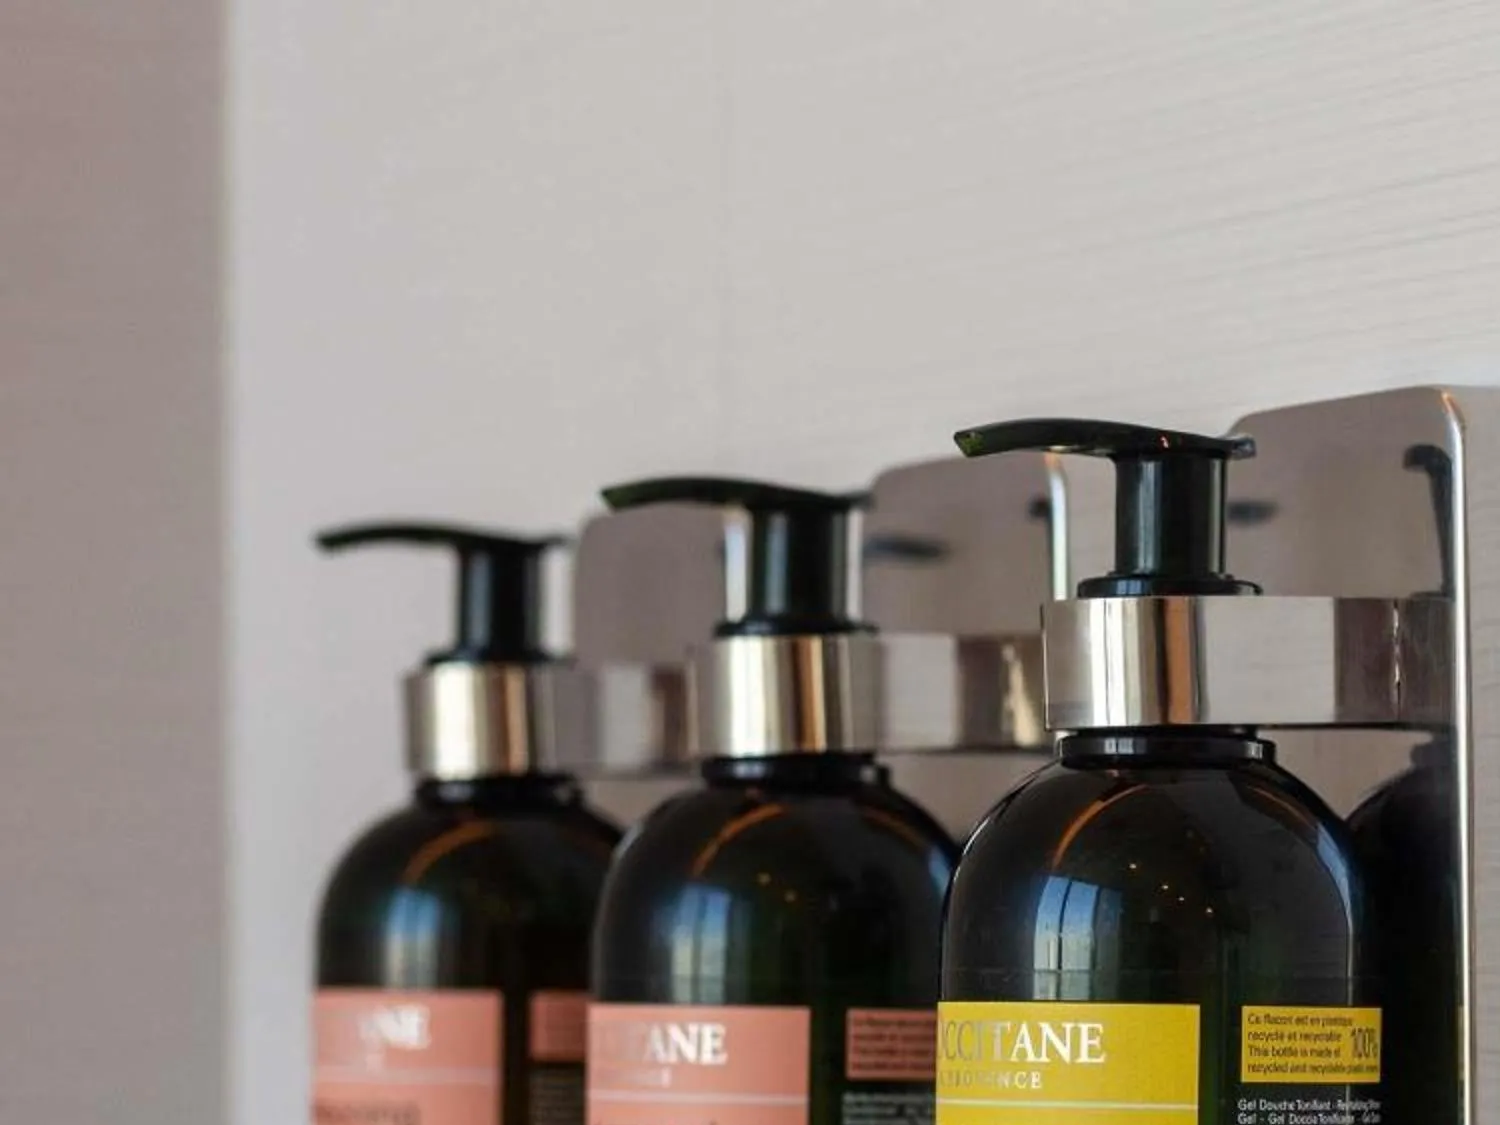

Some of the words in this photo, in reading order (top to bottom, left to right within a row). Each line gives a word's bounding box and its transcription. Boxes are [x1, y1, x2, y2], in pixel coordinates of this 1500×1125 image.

[1247, 1045, 1269, 1057] This
[1271, 1045, 1299, 1057] bottle
[1237, 1098, 1257, 1110] Gel
[1259, 1098, 1296, 1111] Douche
[1237, 1112, 1257, 1125] Gel
[1267, 1112, 1285, 1125] Gel
